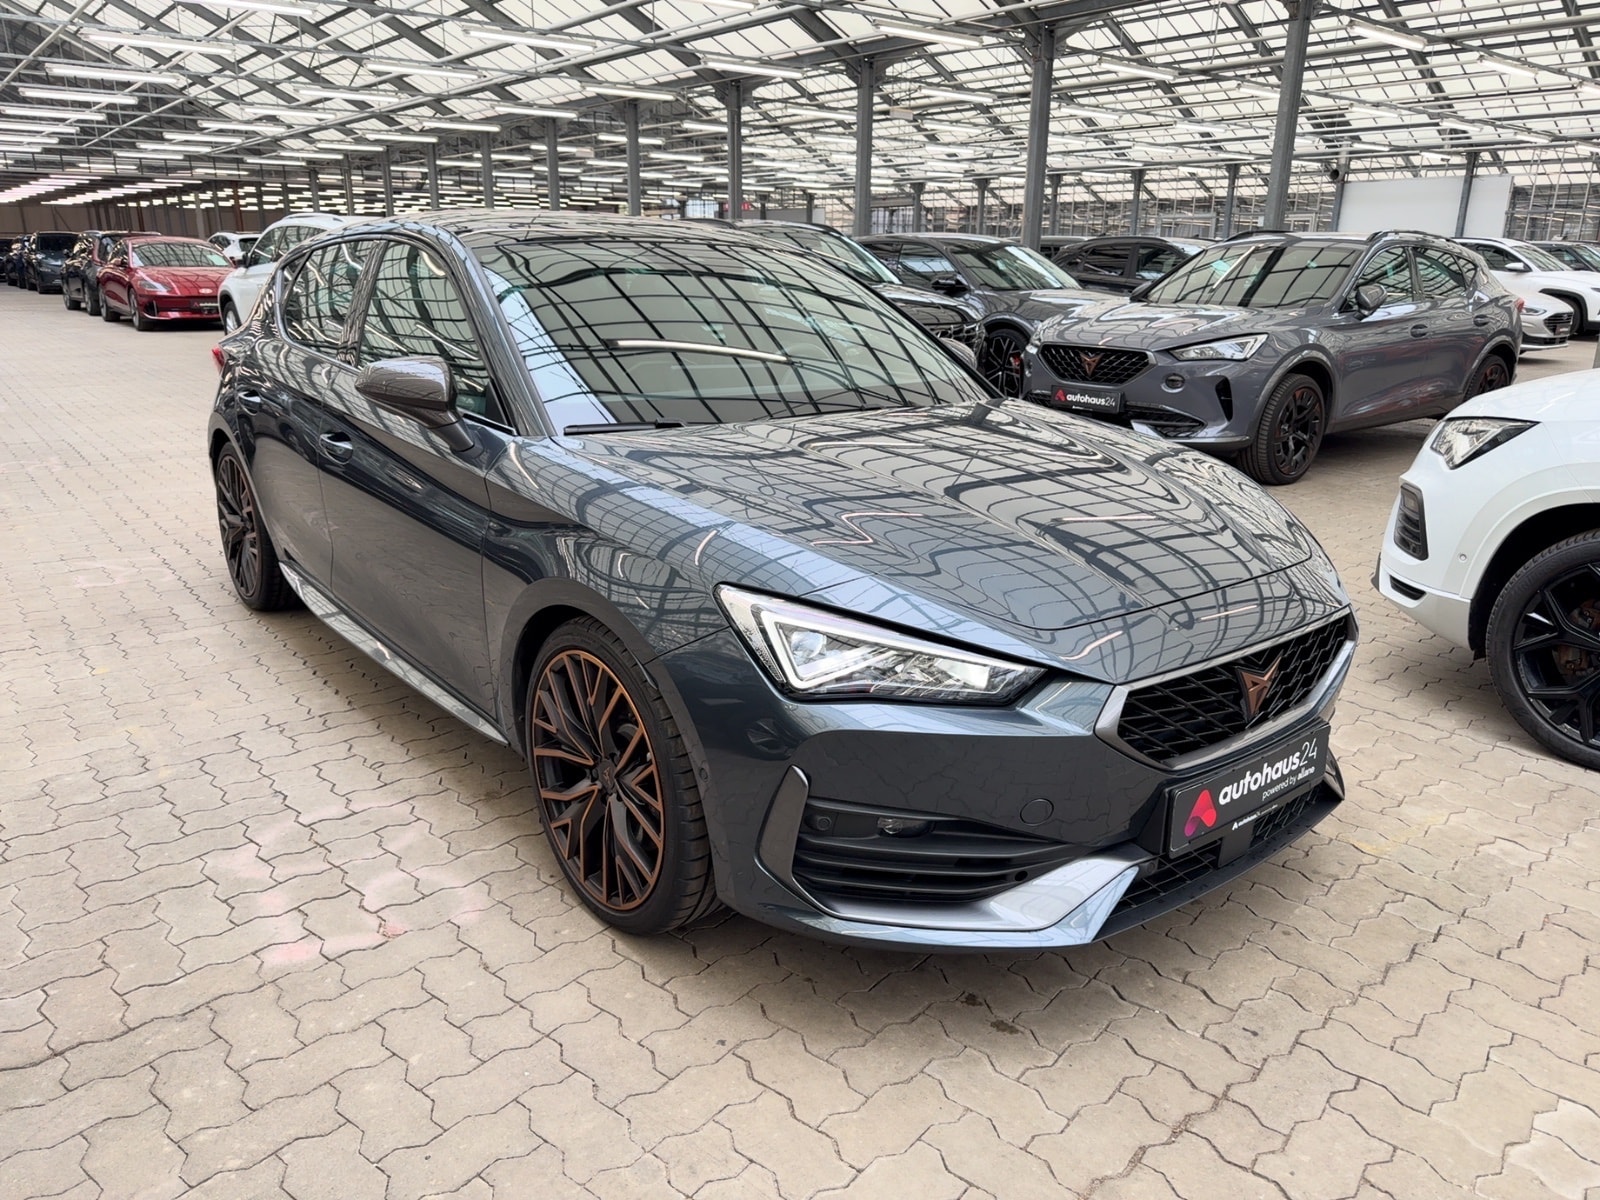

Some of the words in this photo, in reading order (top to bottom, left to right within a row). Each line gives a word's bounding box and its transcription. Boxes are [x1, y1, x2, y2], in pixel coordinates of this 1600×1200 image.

[1066, 393, 1116, 407] autohaus24
[1218, 737, 1318, 806] autohaus24
[1262, 776, 1289, 802] powered
[1289, 775, 1298, 786] by
